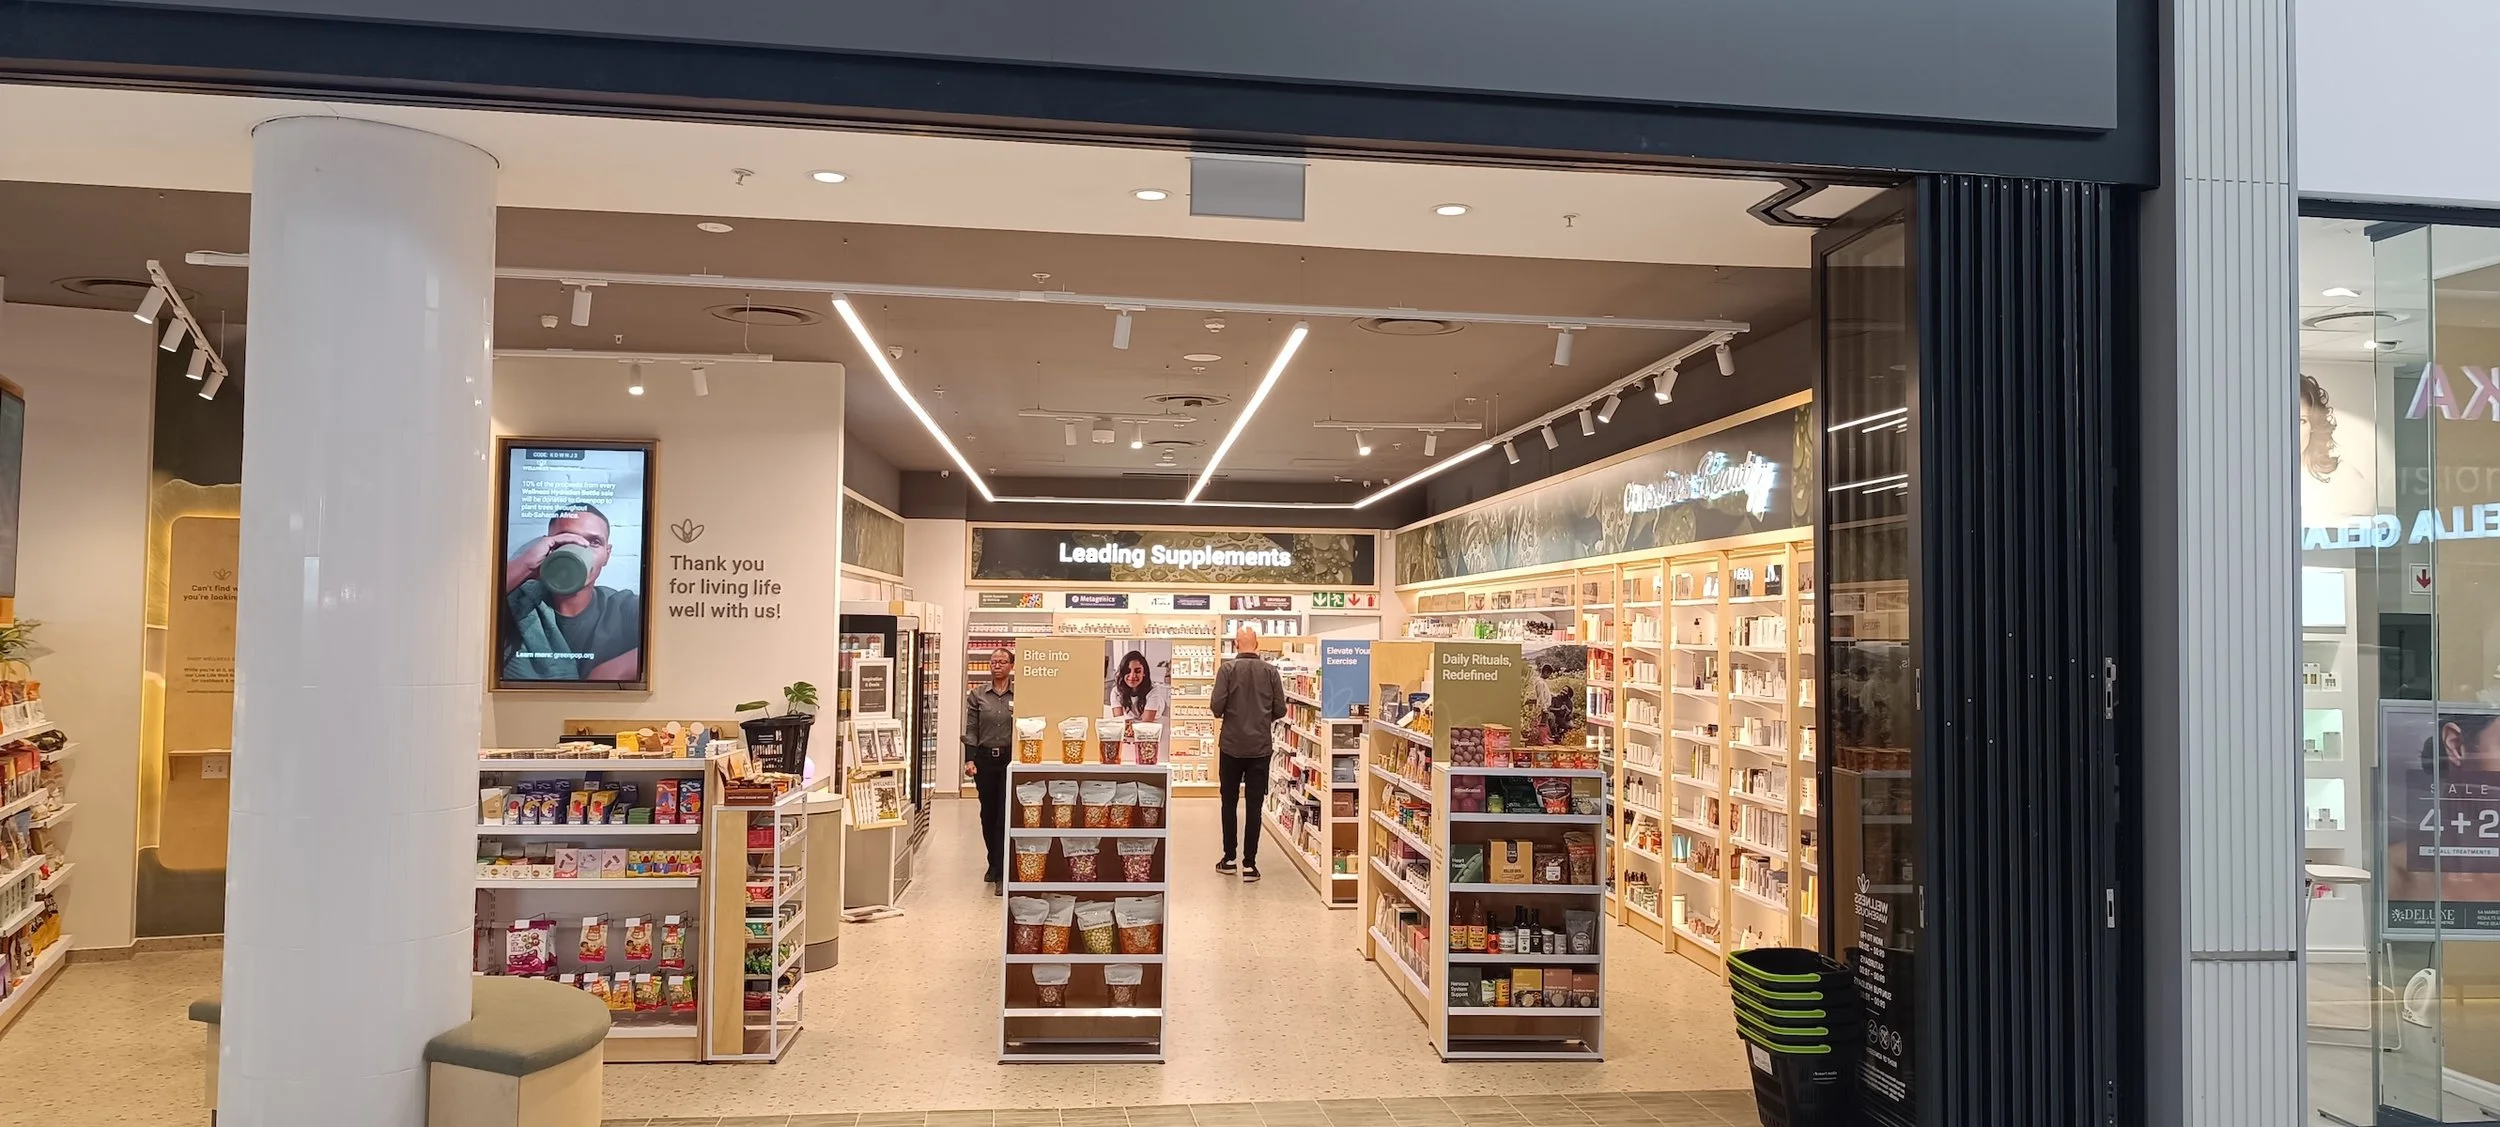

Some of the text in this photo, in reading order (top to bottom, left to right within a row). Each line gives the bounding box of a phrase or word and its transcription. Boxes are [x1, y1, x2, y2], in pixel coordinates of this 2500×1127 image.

[521, 503, 537, 512] plant
[554, 504, 588, 512] throughout
[1059, 542, 1292, 570] Leading Supplements
[670, 555, 765, 575] Thank you
[214, 584, 231, 592] find
[669, 578, 781, 598] for living life
[183, 594, 209, 602] you're
[669, 602, 781, 619] well with us!
[553, 652, 595, 660] greenpop.org
[1023, 649, 1070, 661] Bite into
[1326, 646, 1353, 655] Elevate
[1327, 657, 1358, 665] Exercise
[1442, 654, 1512, 668] Daily Rituals,
[1023, 665, 1059, 677] Better
[1442, 670, 1498, 681] Redefined
[2430, 784, 2489, 795] SALE
[2419, 808, 2499, 839] 4+2
[2452, 847, 2491, 855] TREATMENTS
